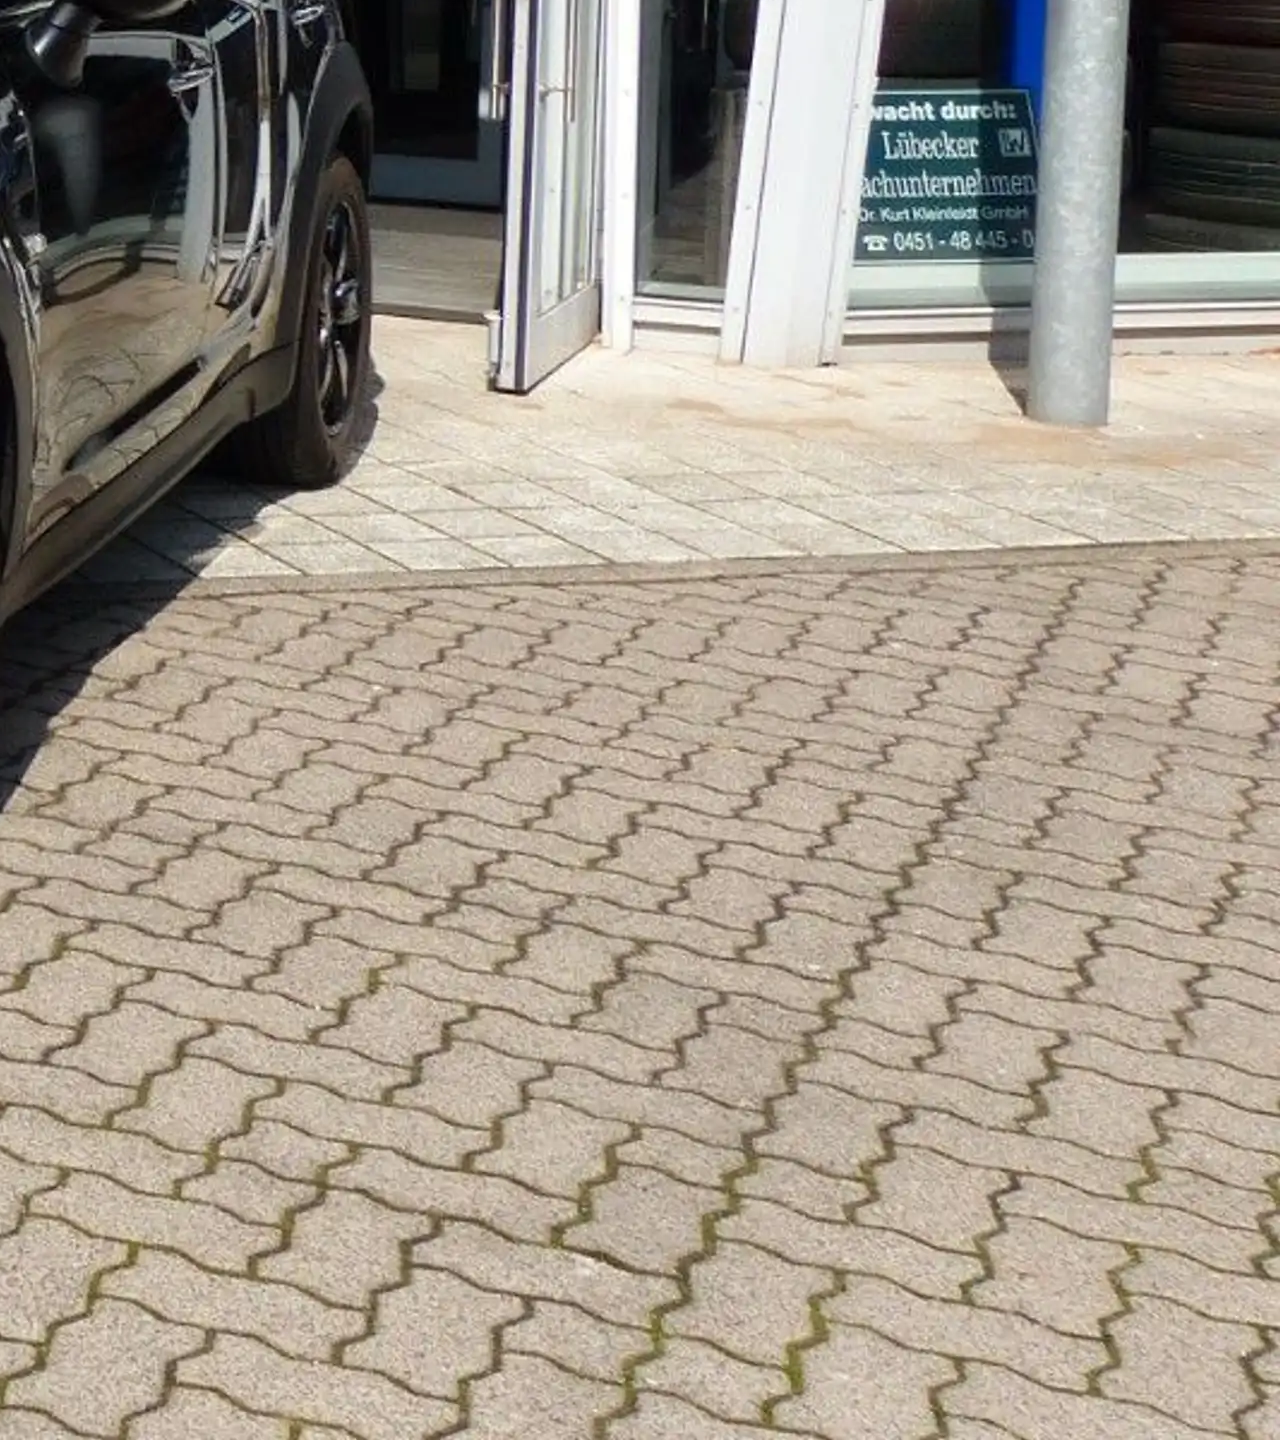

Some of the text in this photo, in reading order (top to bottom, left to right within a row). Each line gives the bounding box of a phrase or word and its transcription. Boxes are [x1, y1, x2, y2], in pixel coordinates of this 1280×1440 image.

[941, 100, 1017, 121] durch:
[881, 129, 979, 160] Lübecker
[893, 231, 934, 251] 0451
[949, 230, 972, 251] 48
